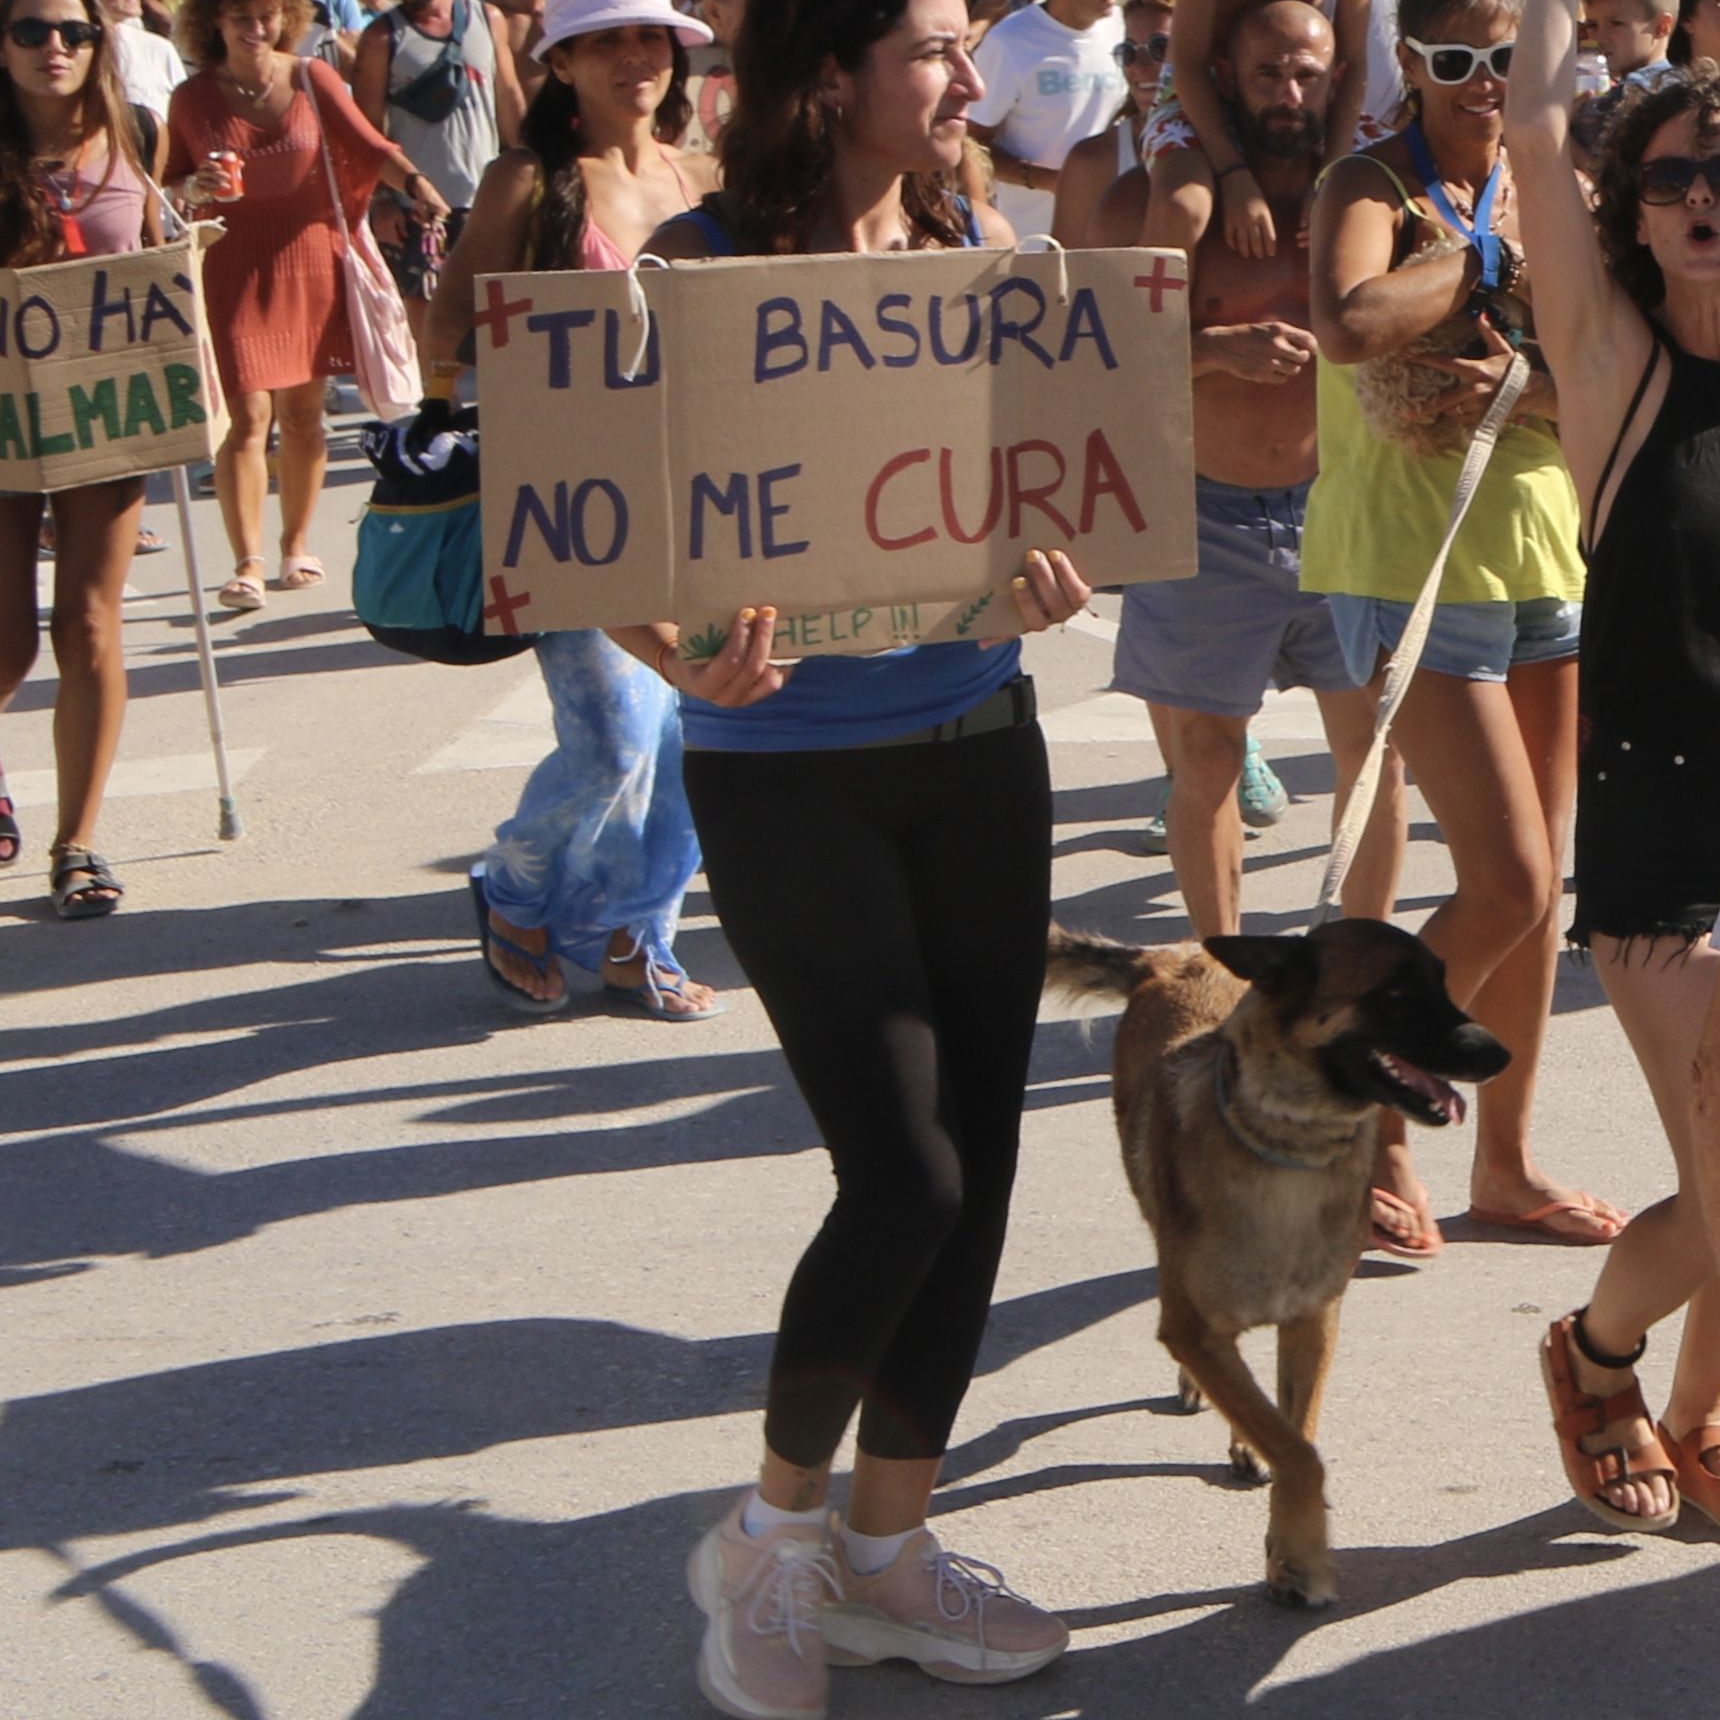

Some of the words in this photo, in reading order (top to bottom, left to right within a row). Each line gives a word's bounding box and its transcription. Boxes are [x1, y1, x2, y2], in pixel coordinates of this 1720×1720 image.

[528, 308, 660, 390] TU
[754, 276, 1118, 383] BASURA
[503, 478, 629, 569] NO
[690, 463, 810, 560] ME
[865, 428, 1147, 552] CURA
[770, 610, 873, 648] HELP
